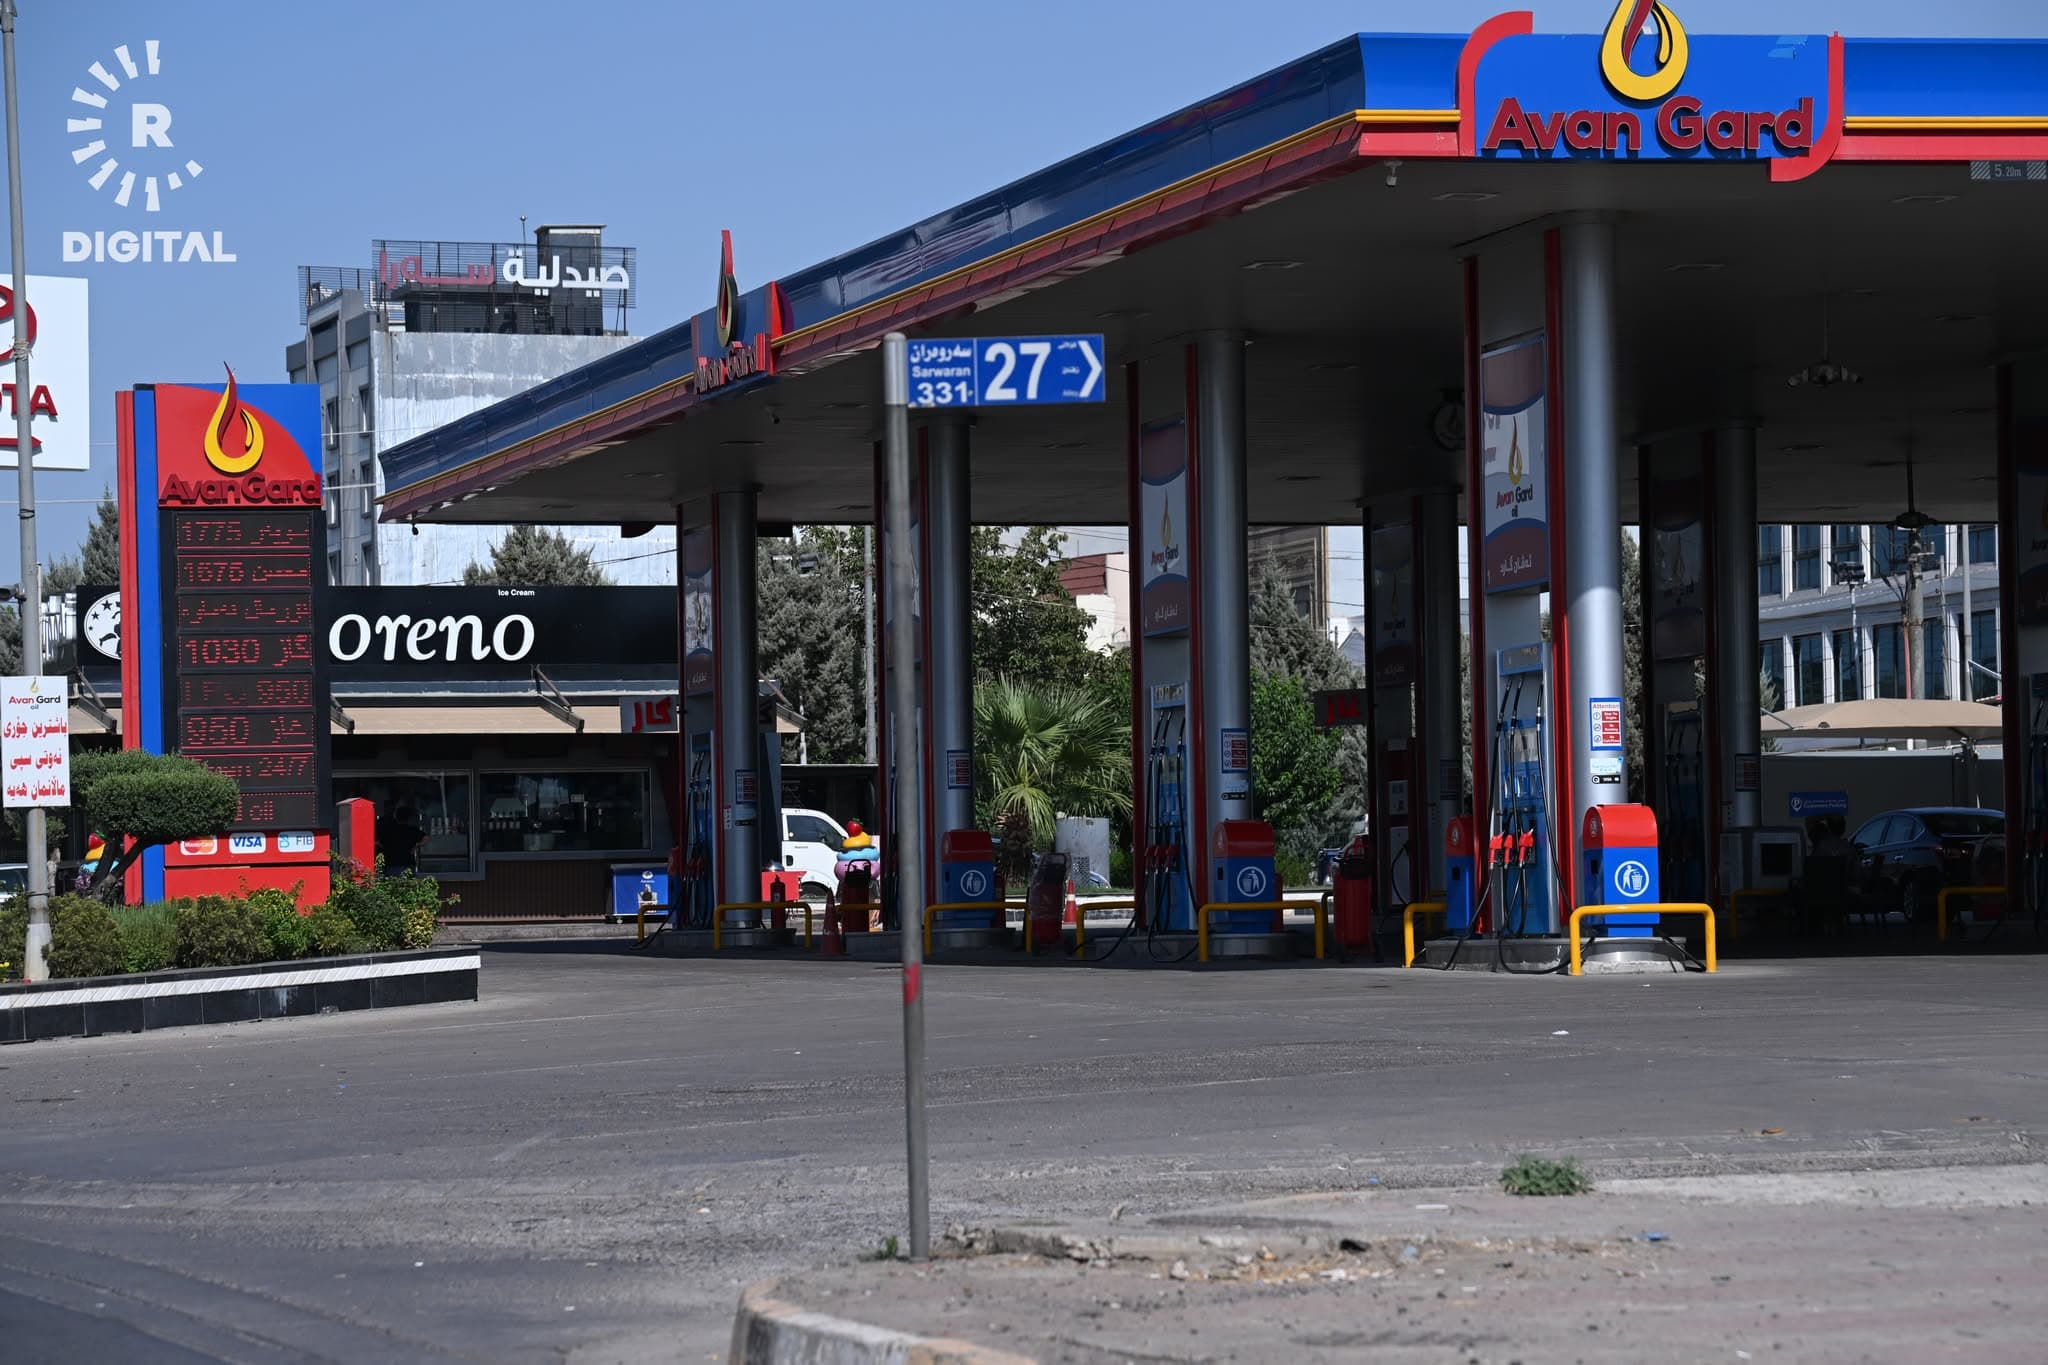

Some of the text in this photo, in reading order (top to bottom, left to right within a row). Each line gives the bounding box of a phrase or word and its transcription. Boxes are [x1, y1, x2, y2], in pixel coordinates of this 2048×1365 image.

[1485, 96, 1814, 150] Avan Gard
[502, 249, 629, 297] صيدلية
[912, 365, 971, 378] Sarwaran
[984, 342, 1051, 400] 27
[917, 381, 968, 405] 331
[1515, 484, 1533, 504] Gard
[497, 588, 535, 596] Ice Cream
[329, 613, 535, 661] oreno
[8, 695, 61, 704] Avan Gard
[233, 836, 262, 848] VISA
[296, 835, 313, 846] FIB
